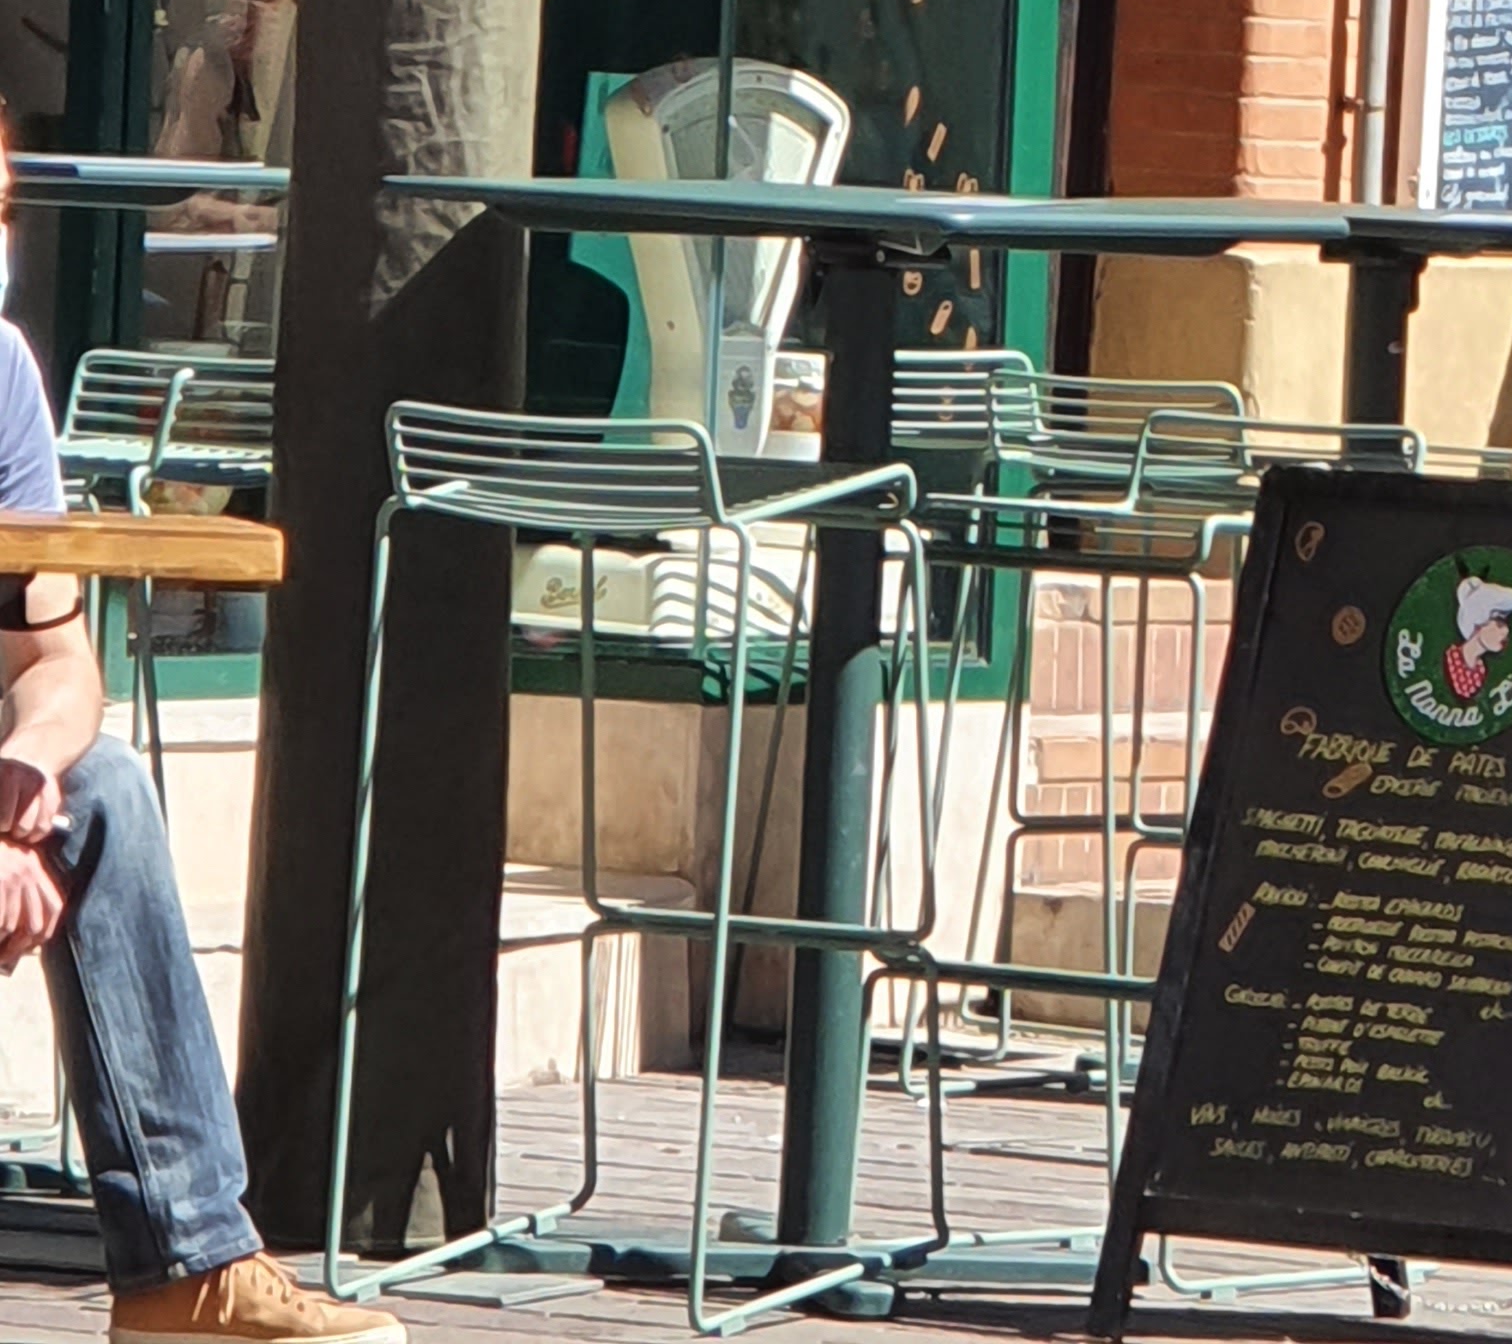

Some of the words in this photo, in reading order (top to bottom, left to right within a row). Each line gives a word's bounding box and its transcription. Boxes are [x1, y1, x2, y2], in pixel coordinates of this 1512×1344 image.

[1397, 628, 1424, 679] La
[1404, 679, 1484, 728] Nonna
[1299, 732, 1398, 765] FABRIQUE
[1406, 744, 1441, 769] DE
[1448, 745, 1506, 779] PÂTES
